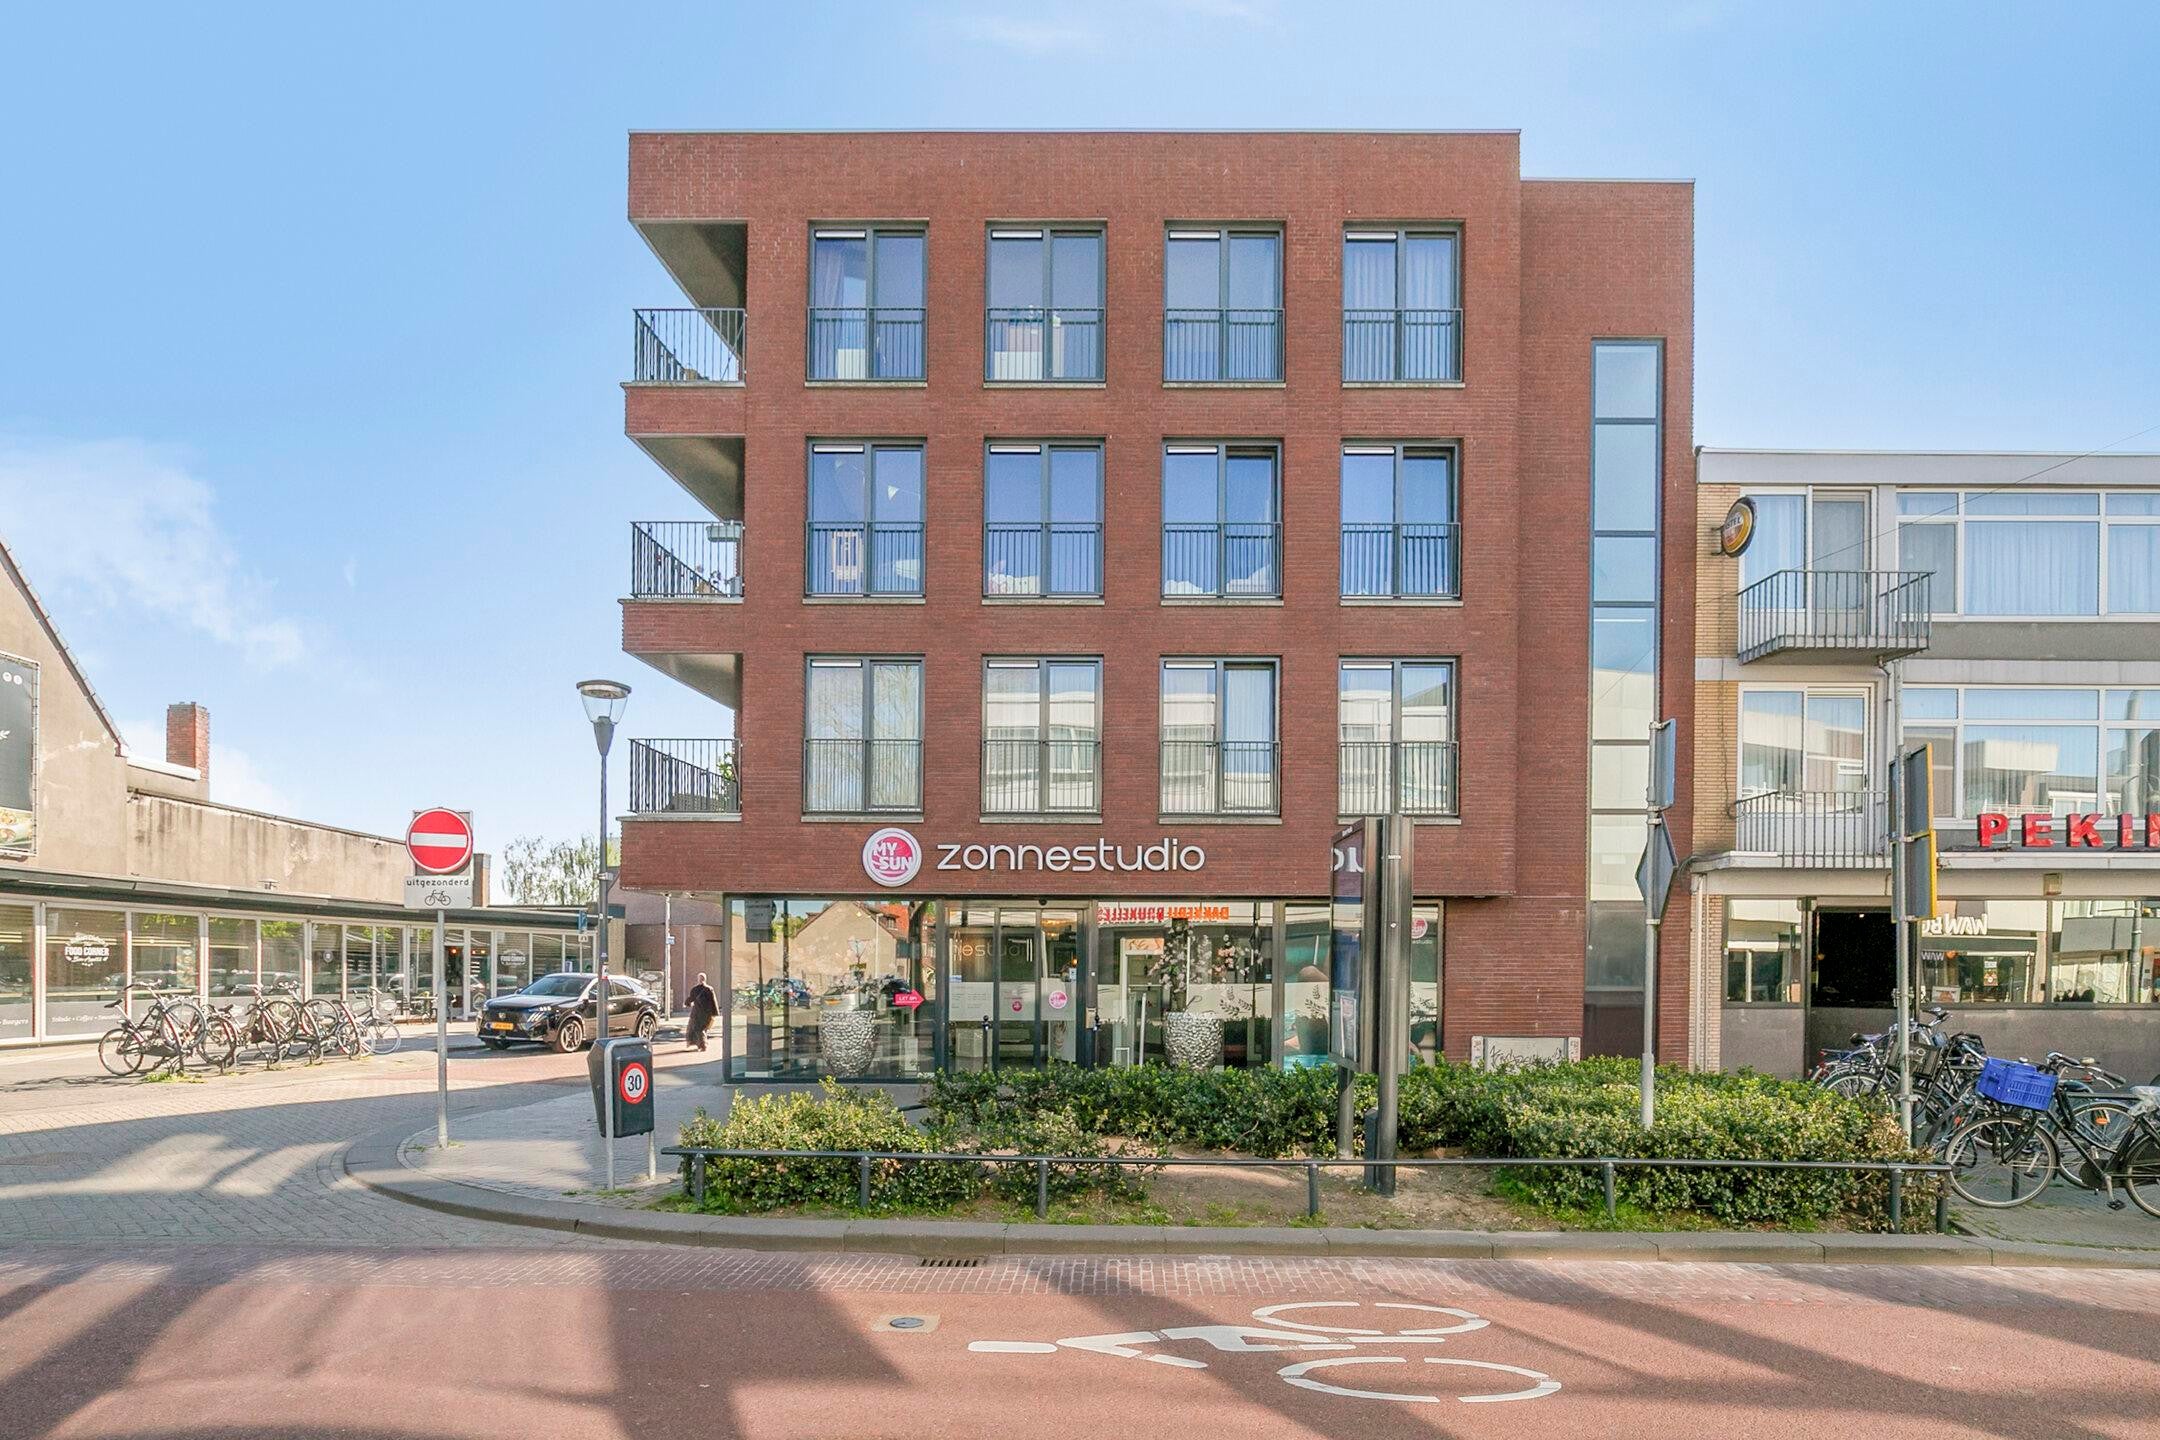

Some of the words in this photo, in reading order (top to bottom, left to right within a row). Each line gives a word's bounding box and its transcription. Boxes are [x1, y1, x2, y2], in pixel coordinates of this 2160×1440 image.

[873, 841, 897, 856] MY
[937, 838, 1206, 872] zonnestudio
[879, 856, 912, 870] SUN
[406, 879, 470, 888] uitgezonderd
[628, 1075, 642, 1091] 30
